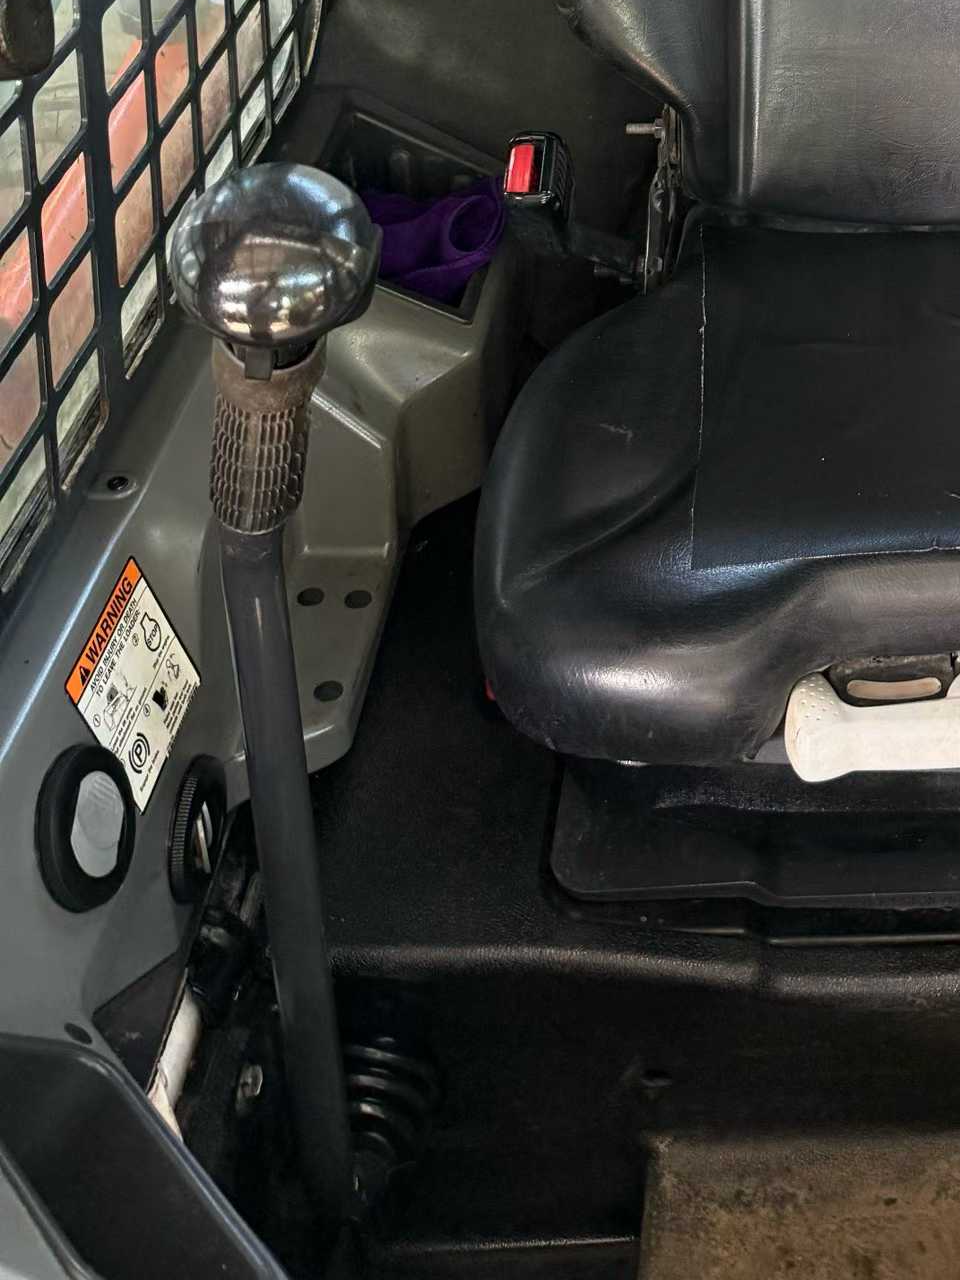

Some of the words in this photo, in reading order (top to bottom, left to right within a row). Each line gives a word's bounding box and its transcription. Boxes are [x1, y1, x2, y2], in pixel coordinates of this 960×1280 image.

[85, 573, 133, 667] WARNING
[89, 664, 104, 693] AVOID
[101, 634, 119, 667] INJURY
[115, 621, 125, 638] OR
[122, 596, 137, 624] DEATH
[96, 683, 104, 698] TO
[102, 657, 116, 685] LEAVE
[114, 640, 125, 659] THE
[122, 606, 141, 643] LOADER:
[145, 621, 159, 648] STOP
